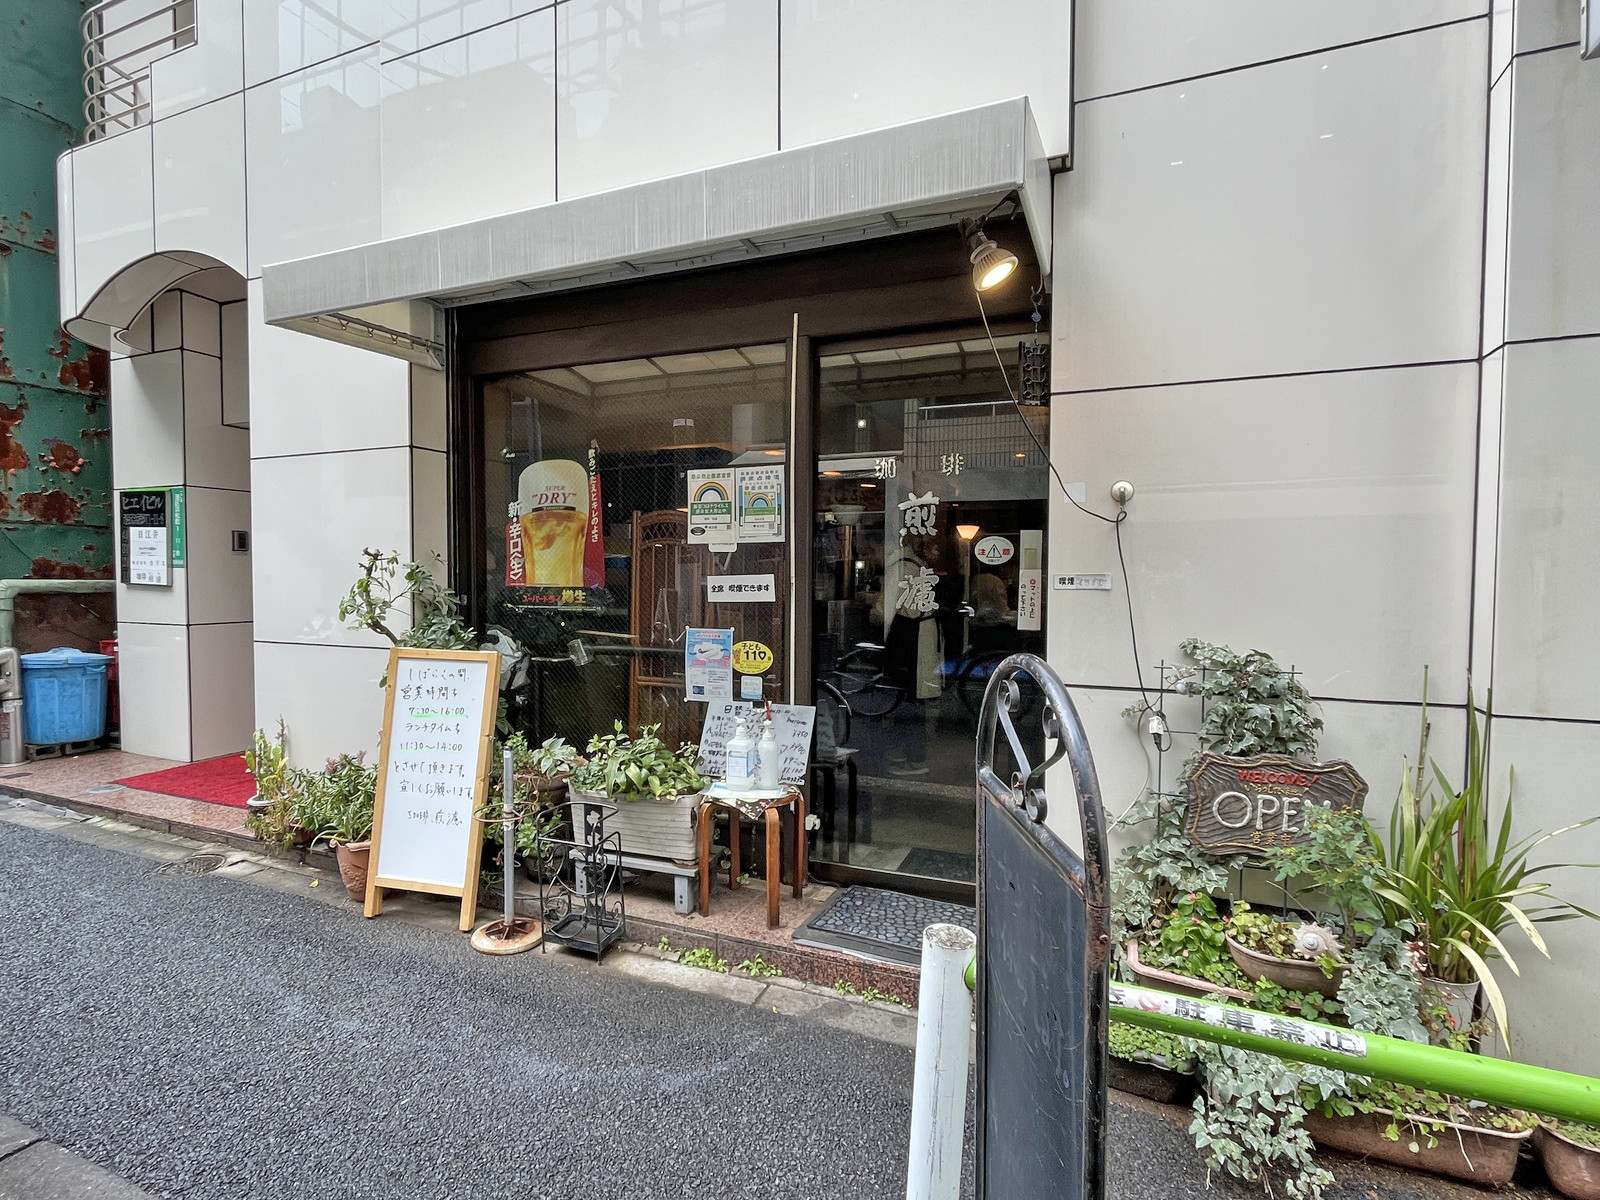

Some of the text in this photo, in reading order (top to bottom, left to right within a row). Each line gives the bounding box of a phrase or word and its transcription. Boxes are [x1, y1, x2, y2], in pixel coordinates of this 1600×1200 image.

[711, 584, 770, 593] 全席 喫煙できます
[741, 642, 761, 650] 子ども
[1250, 831, 1293, 846] 営業中
[1174, 998, 1358, 1054] 駐車禁止
